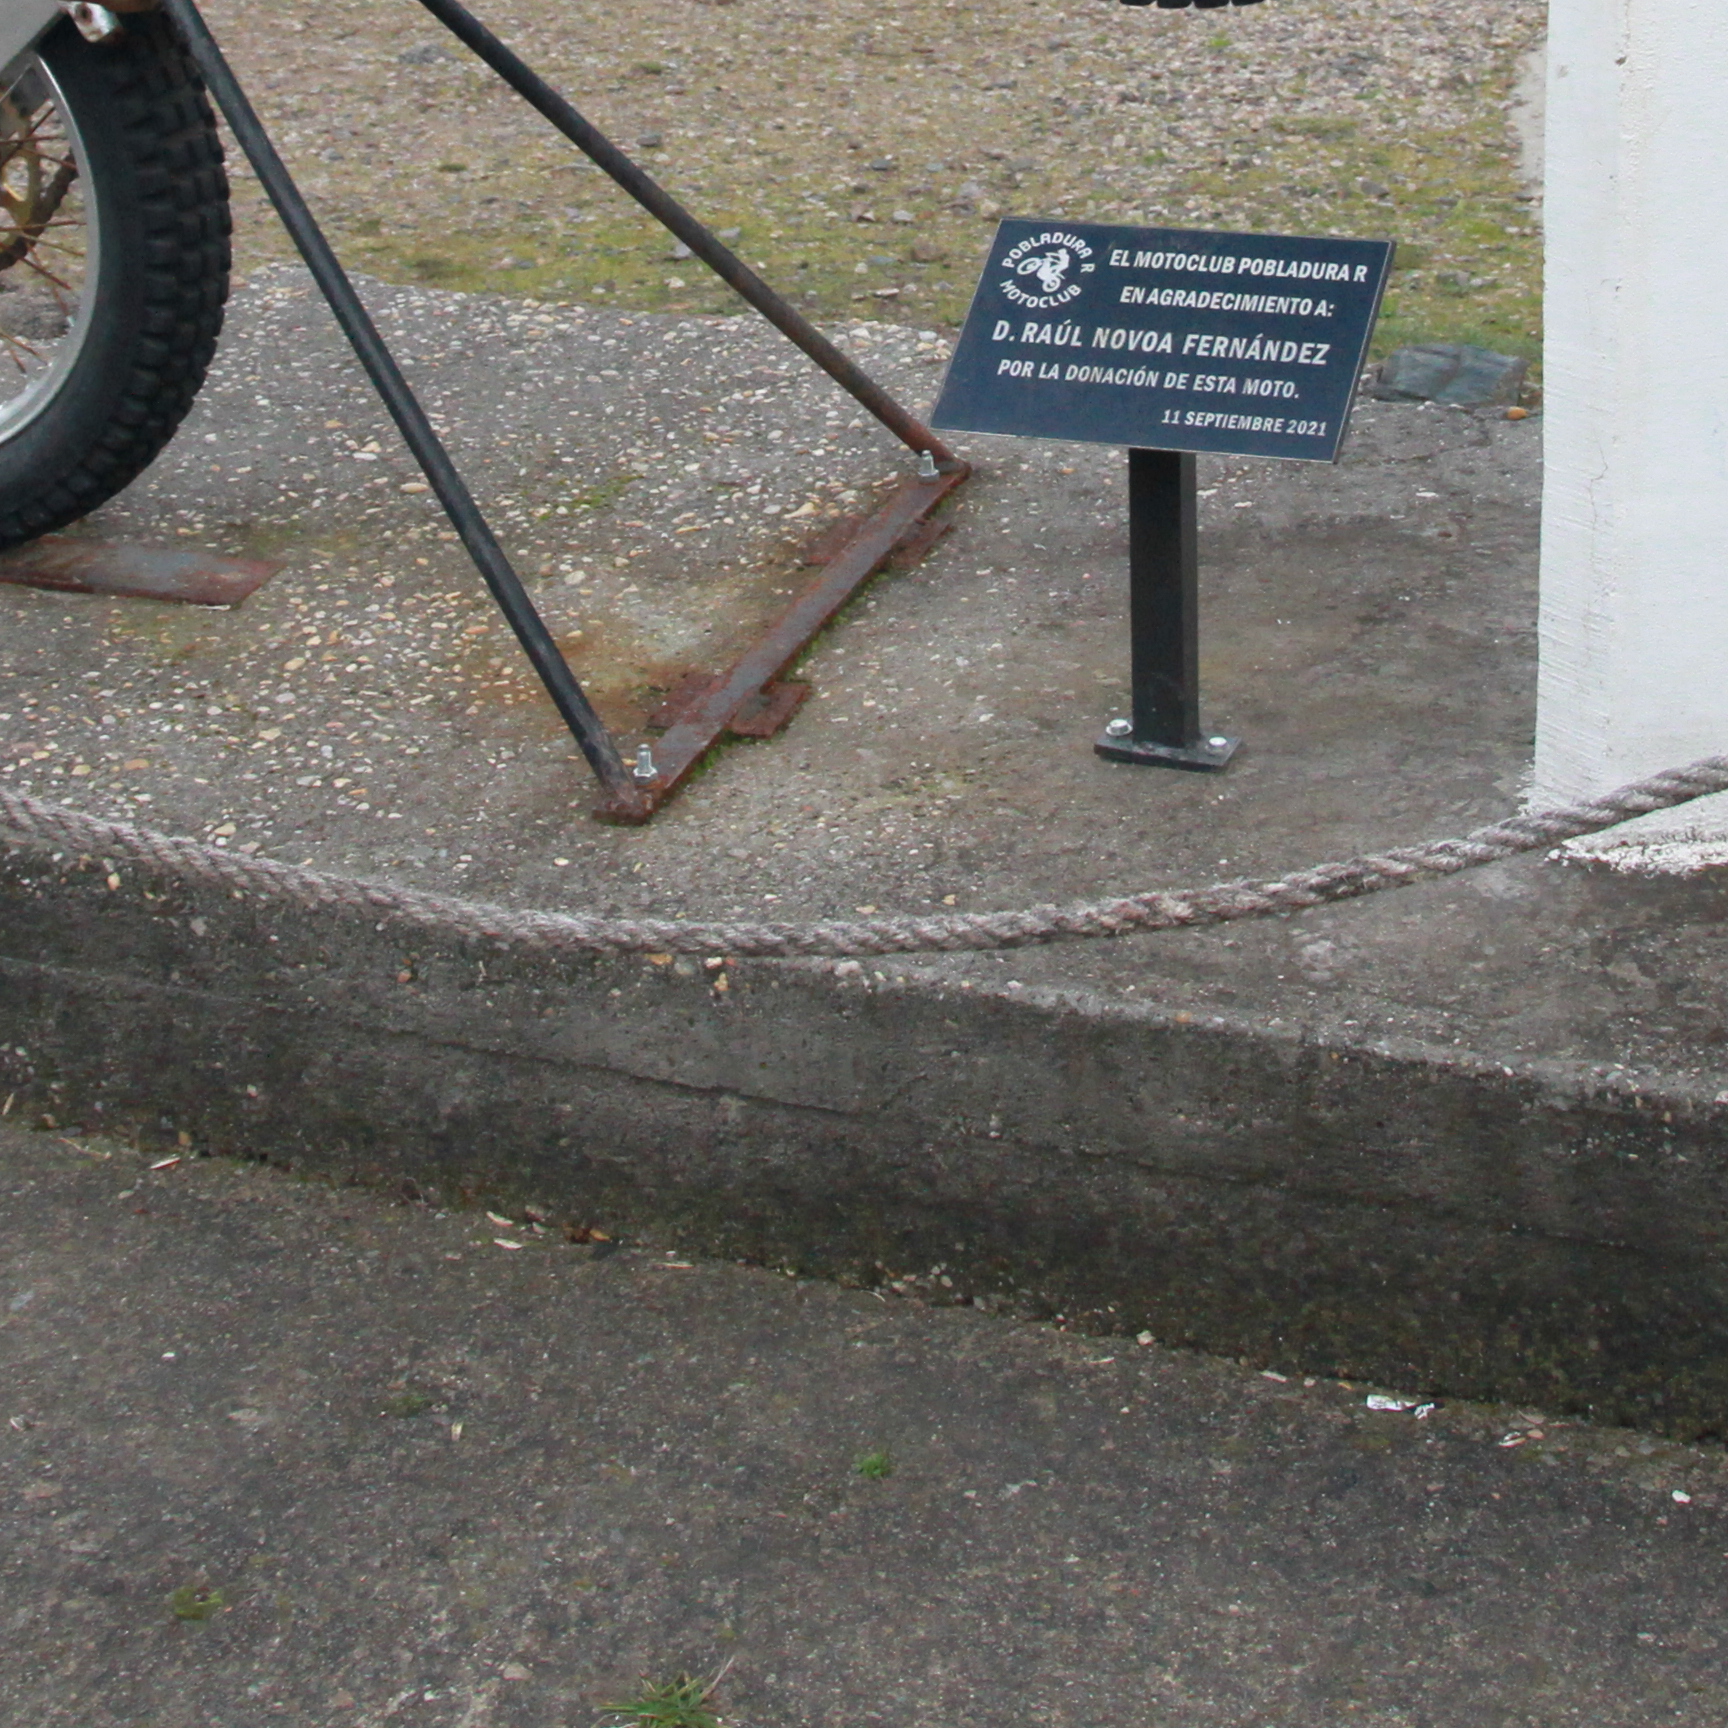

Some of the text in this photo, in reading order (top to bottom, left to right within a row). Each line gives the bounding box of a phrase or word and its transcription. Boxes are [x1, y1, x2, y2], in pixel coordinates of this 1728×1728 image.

[1002, 232, 1095, 273] POBLADURA R
[1109, 249, 1367, 282] EL MOTOCLUB POBLADURA R
[1000, 280, 1081, 308] MOTOCLUB
[1120, 286, 1334, 316] EN AGRADECIMIENTO A:
[992, 319, 1330, 364] D. RAÚL NOVOA FERNÁNDEZ
[997, 359, 1299, 398] POR LA DONACIÓN DE ESTA MOTO.
[1162, 410, 1326, 436] 11 SEPTIEMBRE 2021
